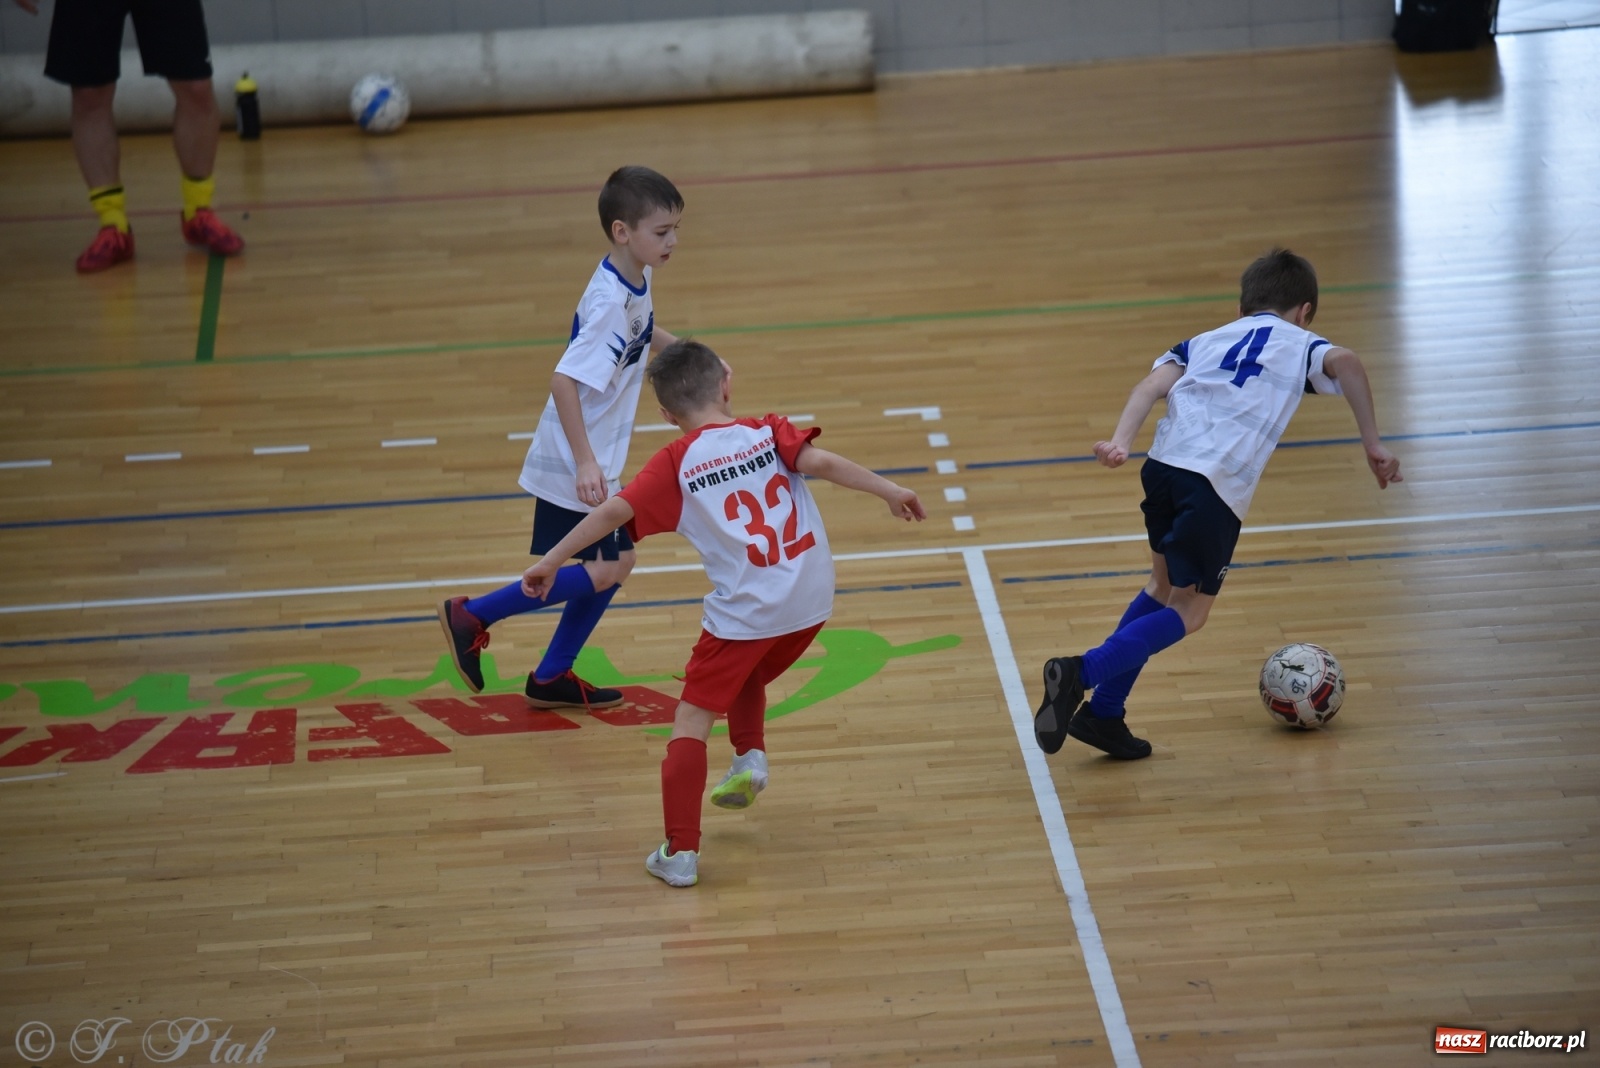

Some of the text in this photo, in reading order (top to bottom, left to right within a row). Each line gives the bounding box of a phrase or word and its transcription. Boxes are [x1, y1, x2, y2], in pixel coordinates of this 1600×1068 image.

[1218, 325, 1274, 389] 4
[683, 454, 733, 479] AKADEMIA
[687, 464, 740, 494] RYMER
[723, 472, 817, 568] 32
